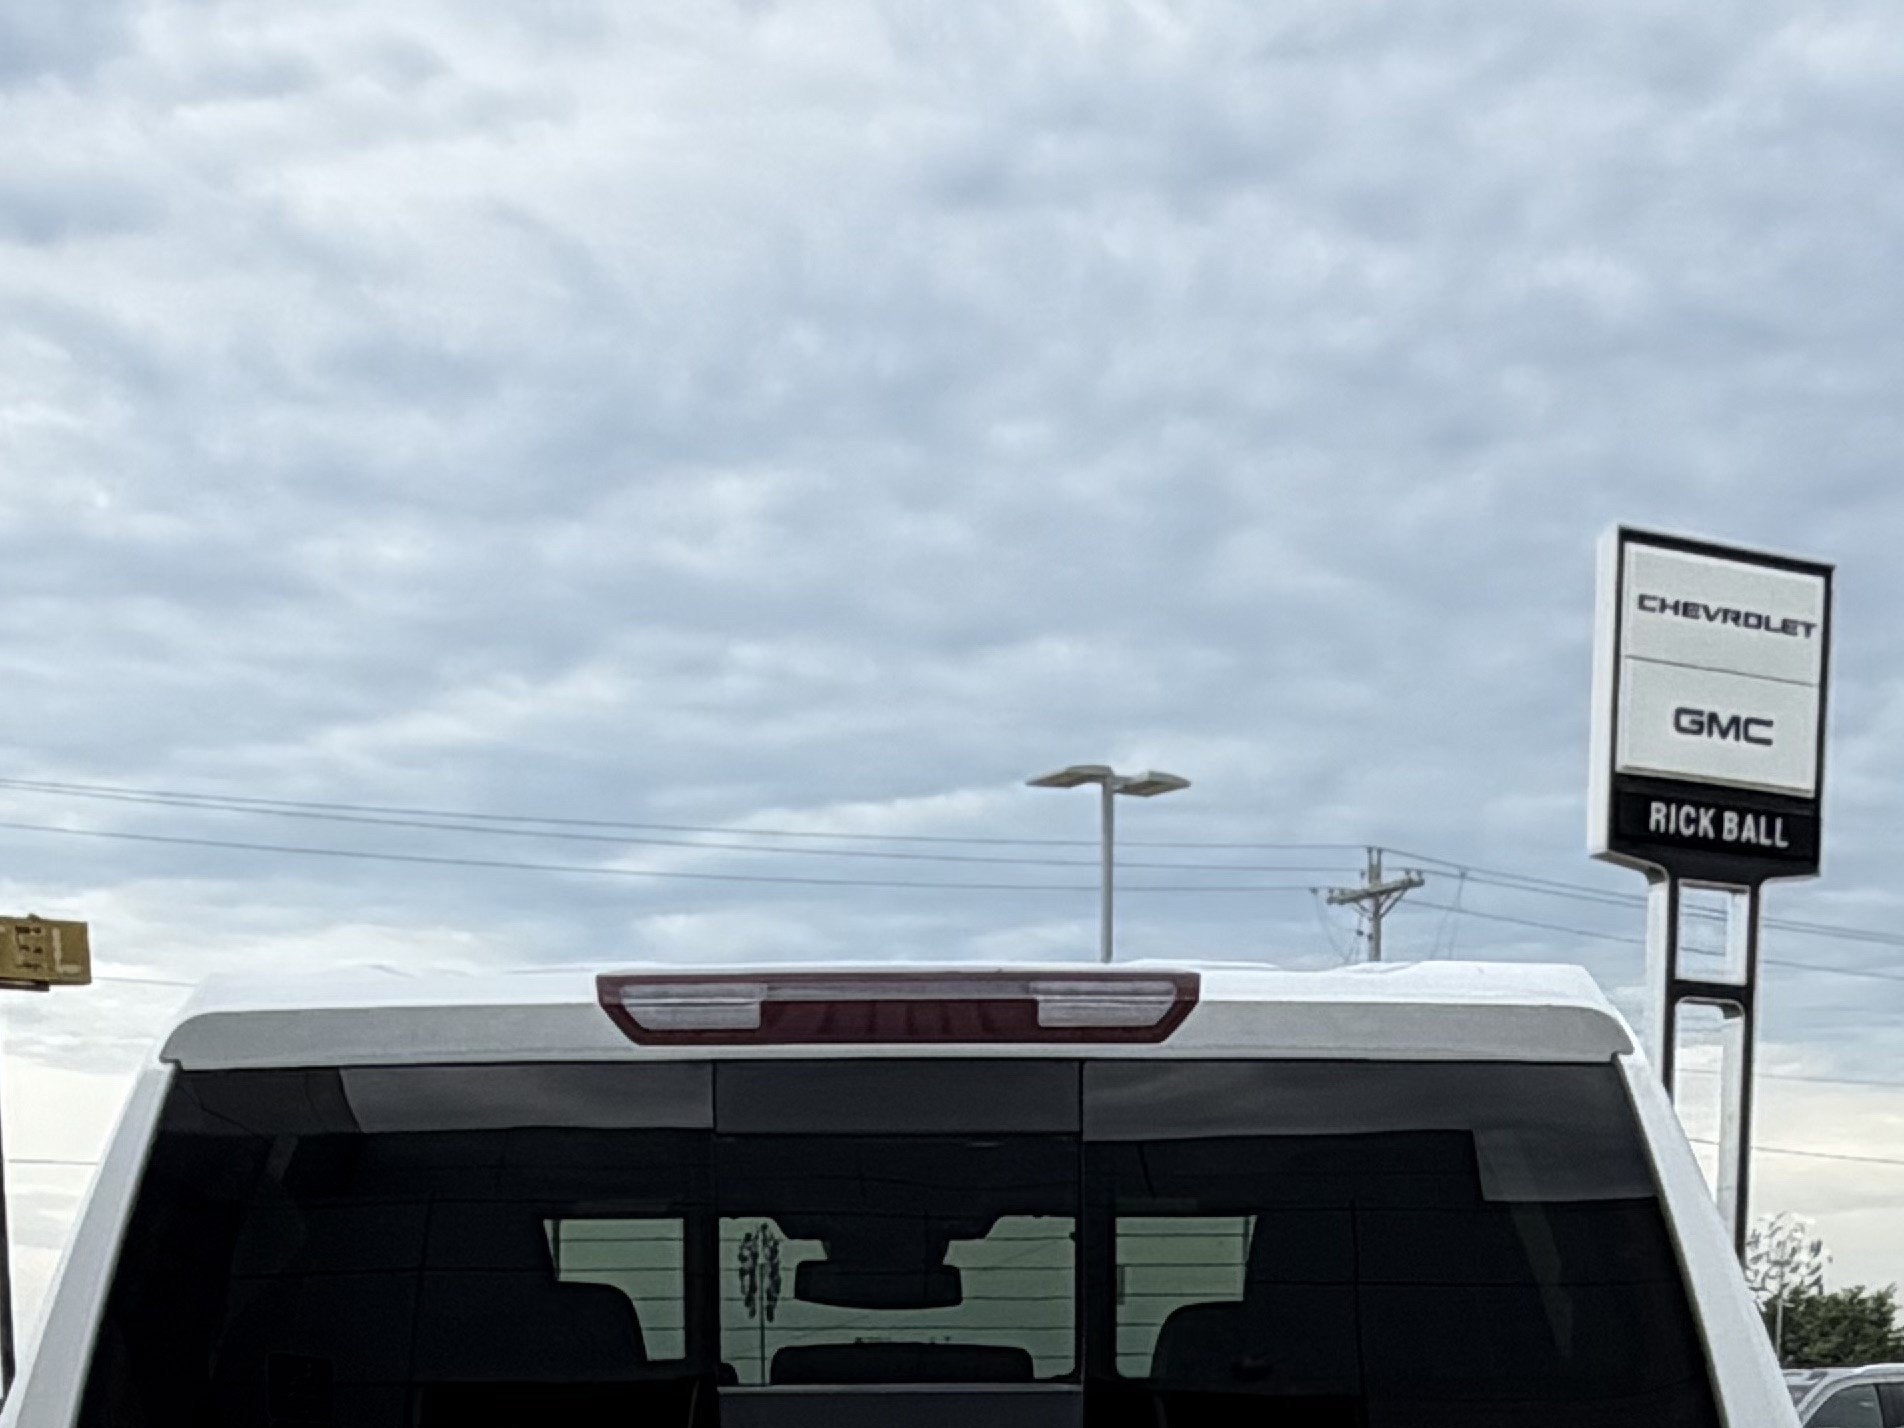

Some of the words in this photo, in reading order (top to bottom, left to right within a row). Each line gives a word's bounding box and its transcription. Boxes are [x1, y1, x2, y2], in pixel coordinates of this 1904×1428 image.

[1637, 593, 1818, 639] CHEVROLET
[1673, 706, 1774, 747] GMC
[1648, 801, 1716, 840] RICK
[1722, 811, 1790, 849] BALL
